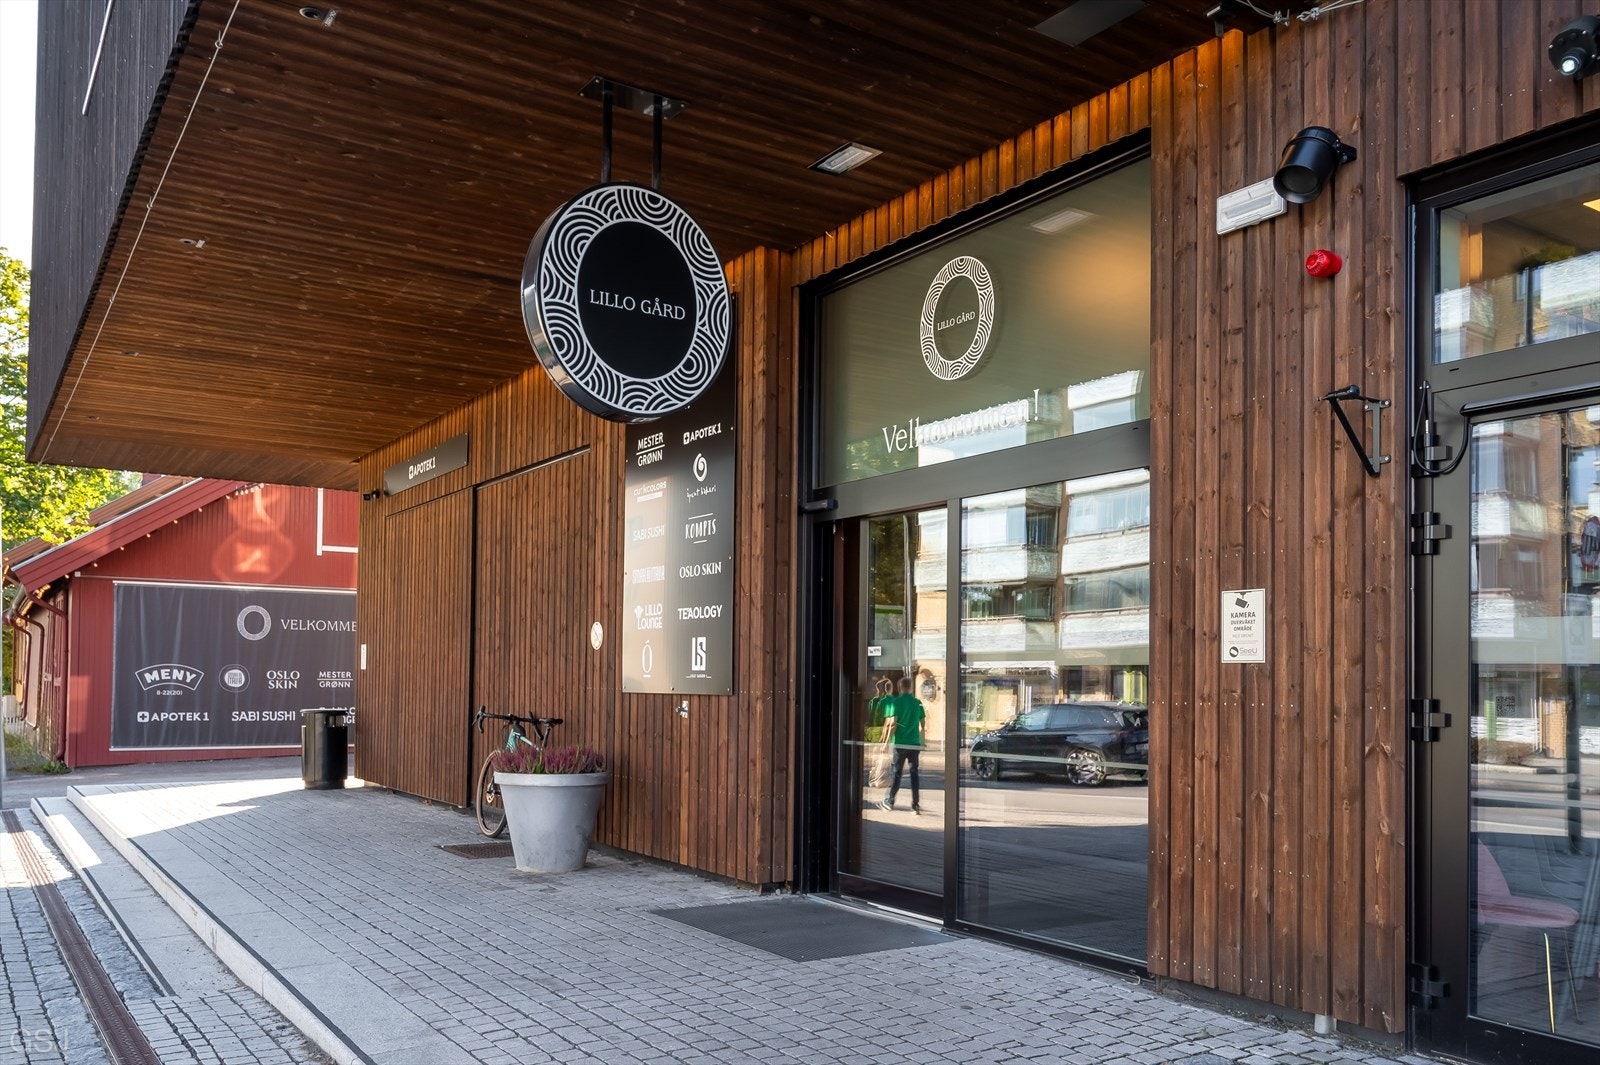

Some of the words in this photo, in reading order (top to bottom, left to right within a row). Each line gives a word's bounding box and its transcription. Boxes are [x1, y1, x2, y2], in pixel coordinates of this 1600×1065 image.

[589, 288, 636, 311] LILLO
[640, 297, 686, 321] GÅRD
[937, 317, 956, 331] LILLO
[956, 311, 976, 325] GÅRD
[637, 432, 664, 451] MESTER
[637, 450, 663, 467] GRØNN
[685, 519, 717, 539] KOMPIS
[679, 564, 701, 579] OSLO
[701, 561, 722, 576] SKIN
[644, 603, 663, 617] LILLO
[677, 605, 723, 620] TEAOLOGY
[280, 619, 357, 632] VELKOMME
[143, 668, 197, 684] MENY
[266, 670, 300, 680] OSLO
[268, 680, 297, 689] SKIN
[319, 680, 351, 688] GRØNN
[151, 712, 201, 721] APOTEK
[231, 711, 260, 721] SABI
[261, 711, 296, 721] SUSHI
